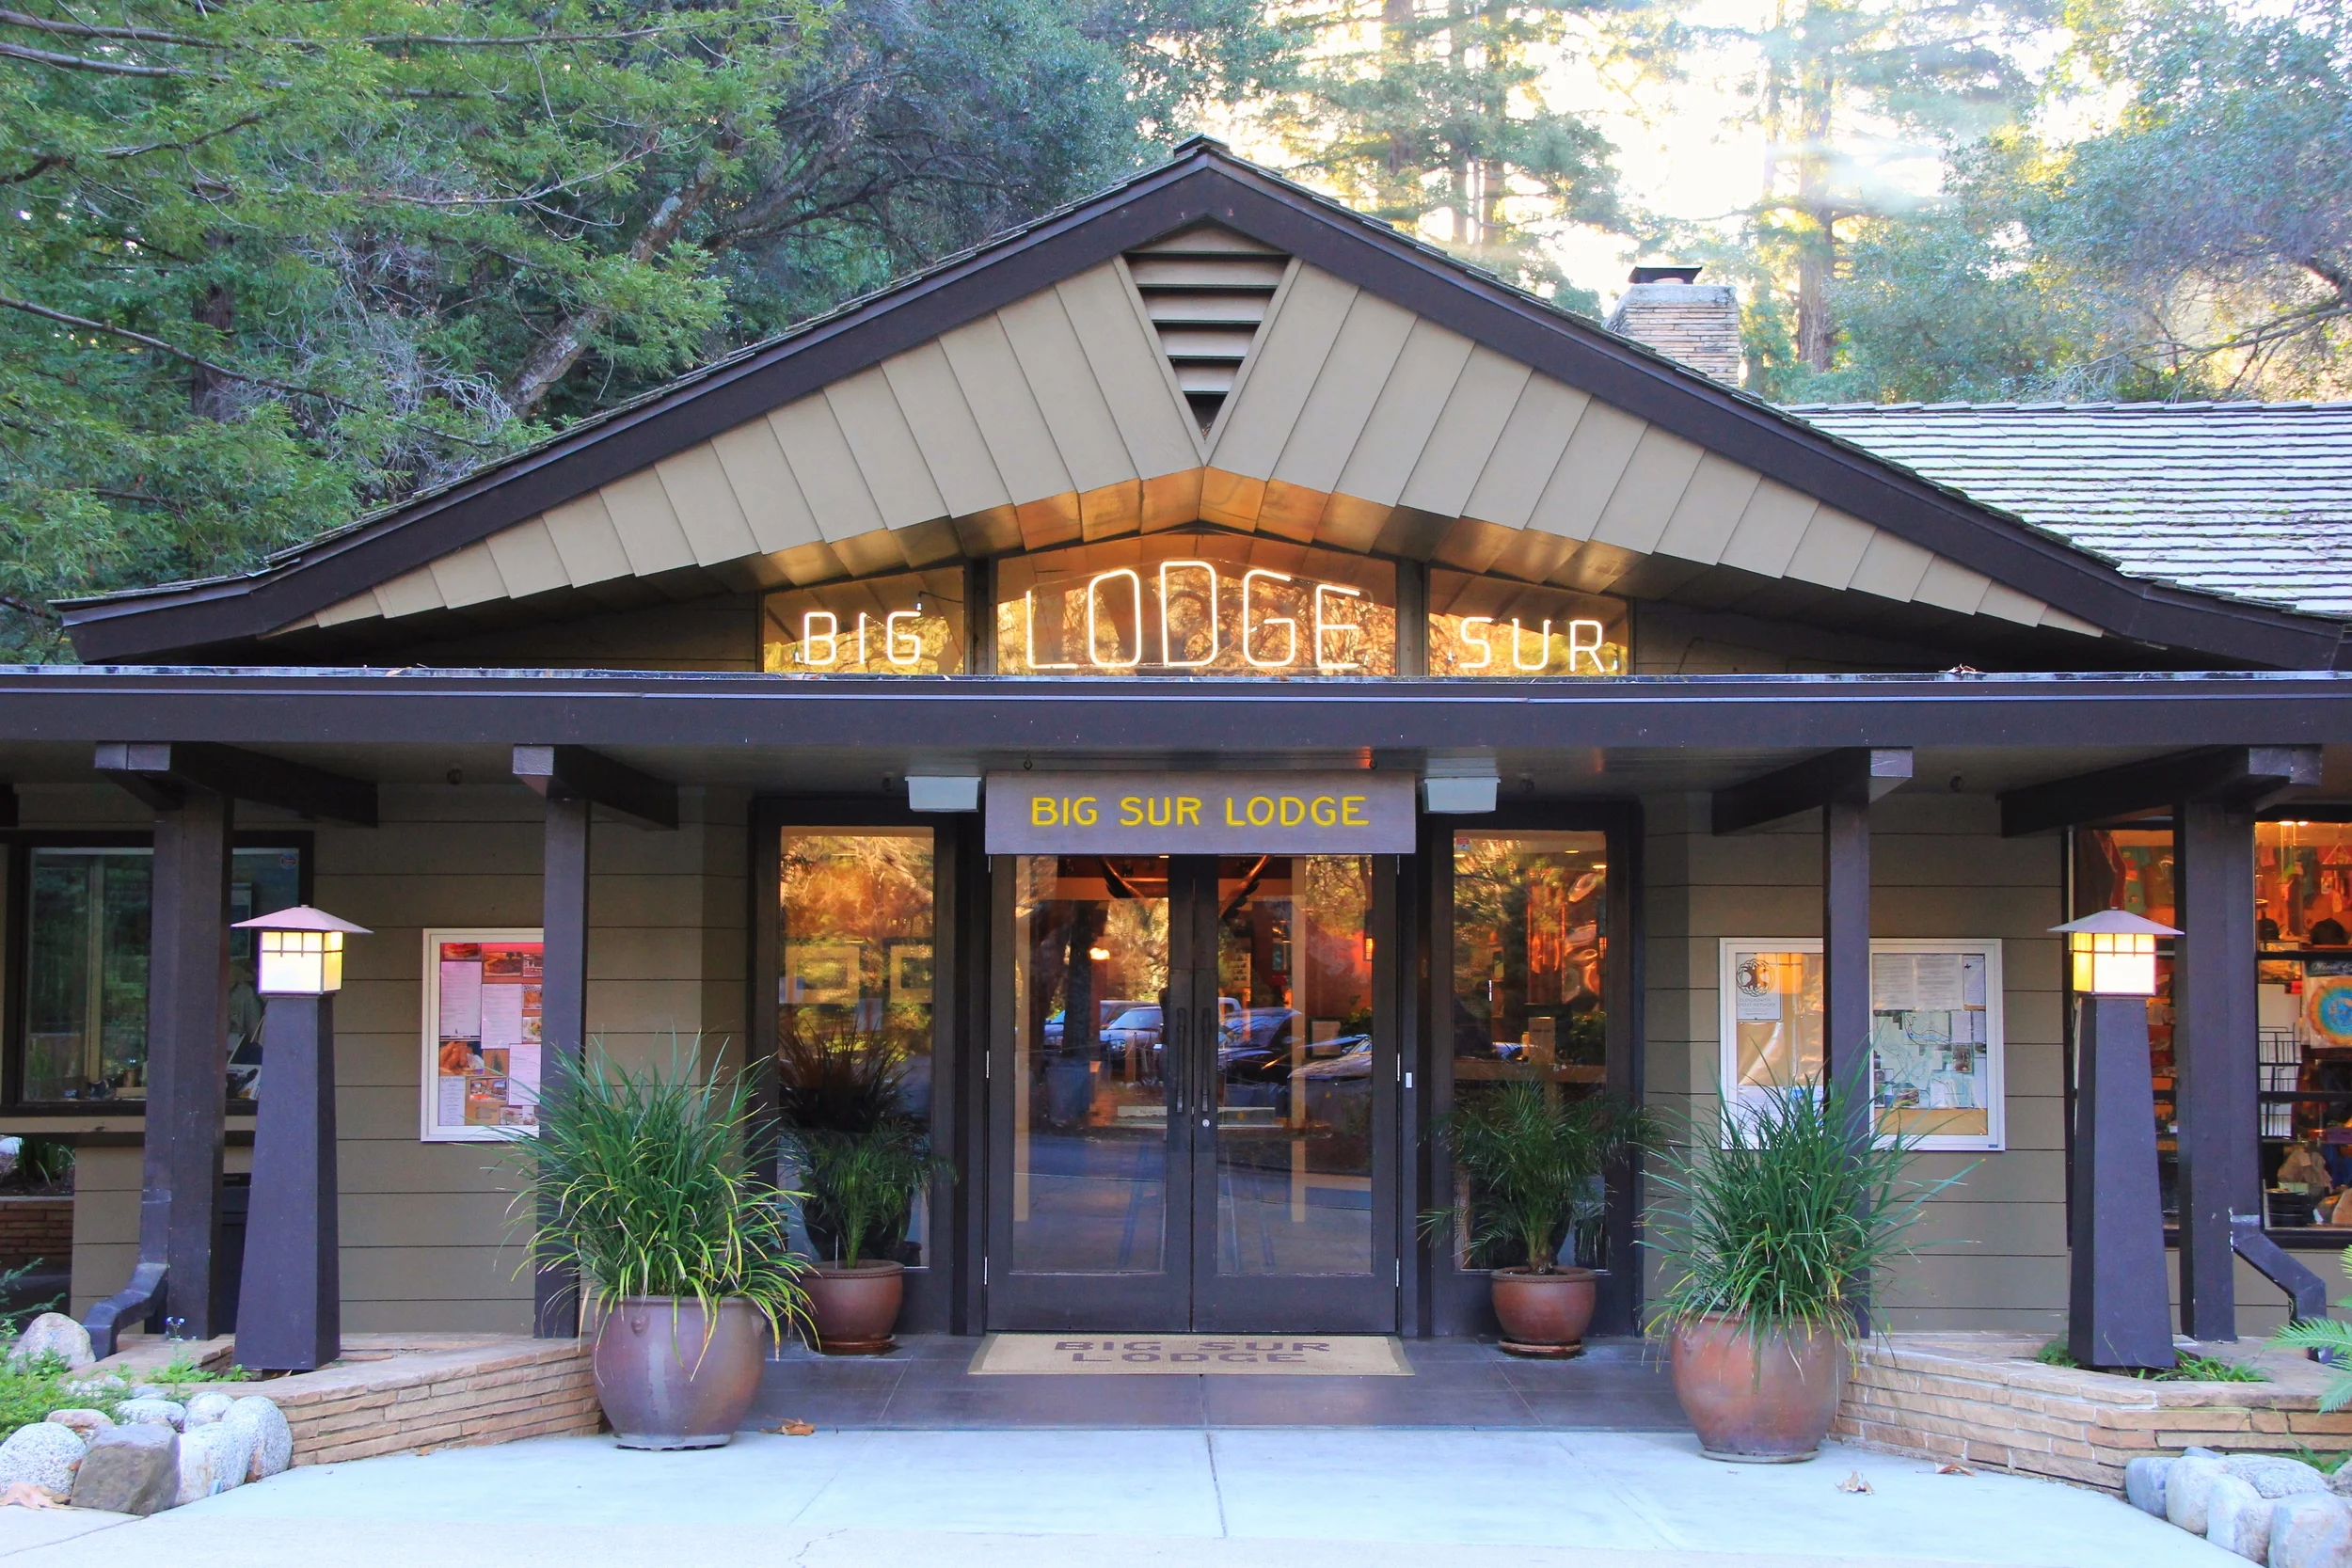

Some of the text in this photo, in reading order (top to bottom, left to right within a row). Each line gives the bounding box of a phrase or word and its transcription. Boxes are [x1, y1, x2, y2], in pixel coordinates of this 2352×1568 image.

[803, 561, 1605, 673] BIG LODGE SUR
[1031, 796, 1369, 827] BIG SUR LODGE
[1055, 1341, 1330, 1352] BIG SUR
[1073, 1353, 1307, 1363] LODGE
